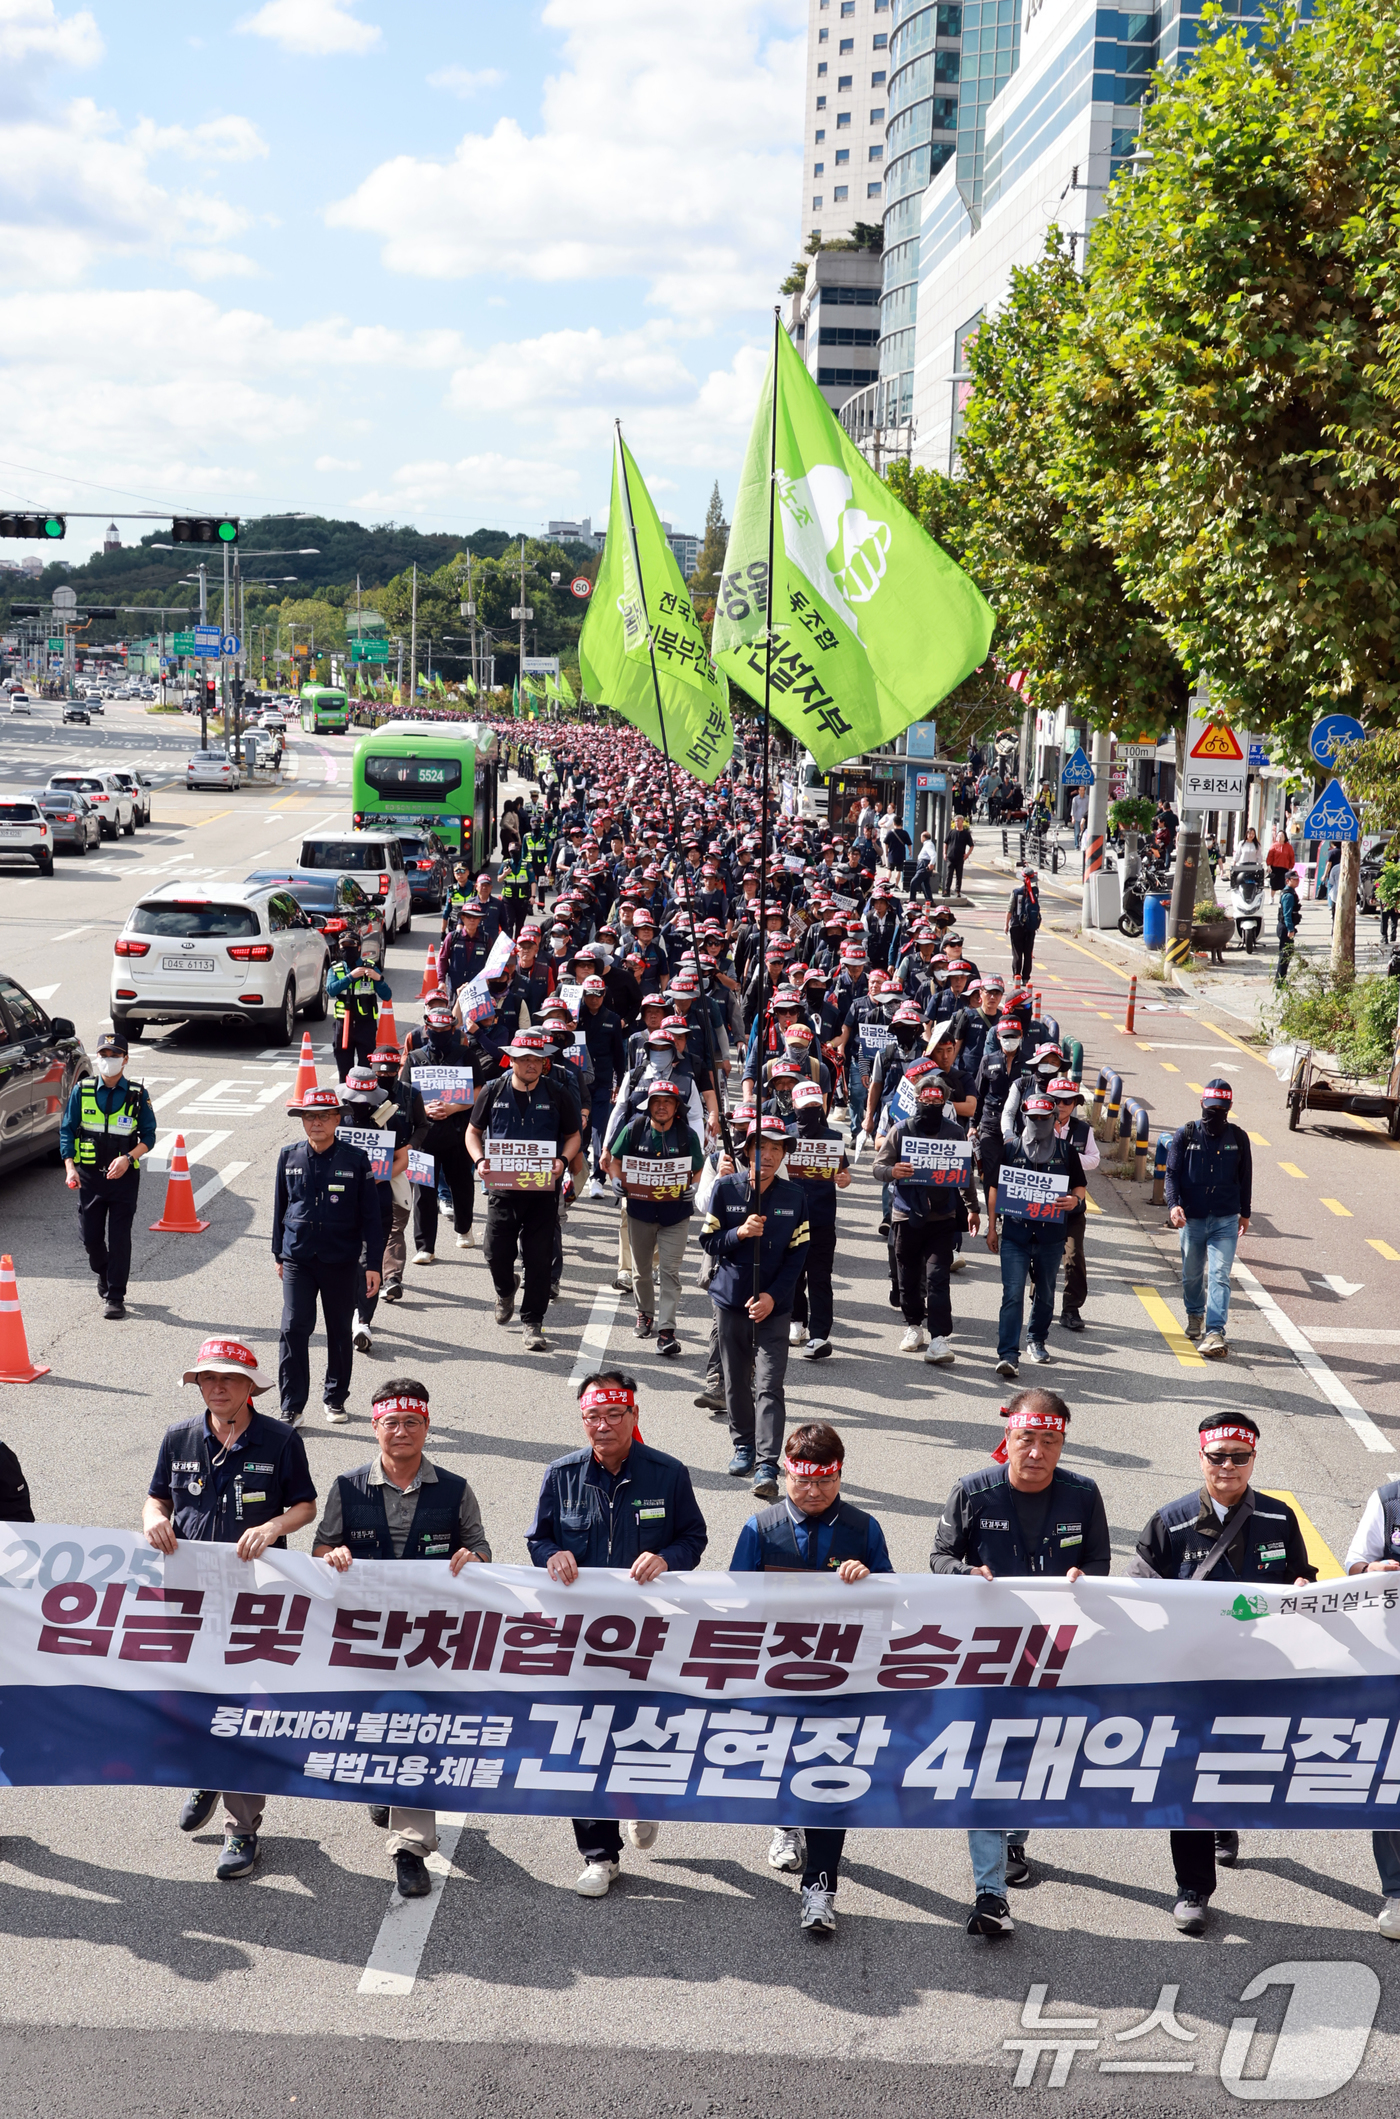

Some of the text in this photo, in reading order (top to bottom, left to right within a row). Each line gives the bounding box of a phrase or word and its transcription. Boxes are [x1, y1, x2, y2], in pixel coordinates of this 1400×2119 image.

[575, 583, 588, 592] 50
[1124, 747, 1149, 757] 100m
[418, 769, 444, 782] 5524
[1188, 777, 1243, 794] 우회전시
[1310, 830, 1352, 841] 자전거횡단
[187, 960, 209, 970] 6113
[413, 1068, 460, 1079] 임금인상
[419, 1079, 468, 1090] 단체협약
[439, 1088, 471, 1102] 쟁취!
[335, 1129, 380, 1146] 금인상
[488, 1142, 539, 1156] 불법고용
[904, 1140, 957, 1156] 임금인상
[489, 1158, 553, 1173] 불법하도급
[626, 1157, 676, 1173] 불법고용
[910, 1155, 964, 1171] 단체협약
[515, 1171, 552, 1189] 근절!
[626, 1172, 689, 1187] 불법하도급
[930, 1169, 967, 1185] 쟁취!
[1002, 1169, 1054, 1190] 임금인상
[1006, 1184, 1060, 1205] 단체협약
[1025, 1202, 1061, 1219] 쟁취!
[224, 1345, 248, 1361] 투쟁
[608, 1390, 628, 1403] 투쟁
[377, 1398, 428, 1414] 단결 투쟁
[1010, 1413, 1063, 1431] 단결 투쟁
[1205, 1426, 1255, 1444] 단결 투쟁
[981, 1520, 1009, 1530] 단결투쟁
[350, 1530, 375, 1540] 단결투쟁
[0, 1539, 164, 1594] 2025
[1279, 1588, 1400, 1616] 전국건설노동
[37, 1581, 206, 1664] 임금
[224, 1592, 313, 1666] 및
[328, 1607, 671, 1681] 단체협약
[678, 1617, 864, 1693] 투쟁
[875, 1623, 1078, 1690] 승리!
[513, 1702, 1400, 1806] 건설현장 4대악 근절!
[301, 1750, 505, 1790] 불법고용·체불
